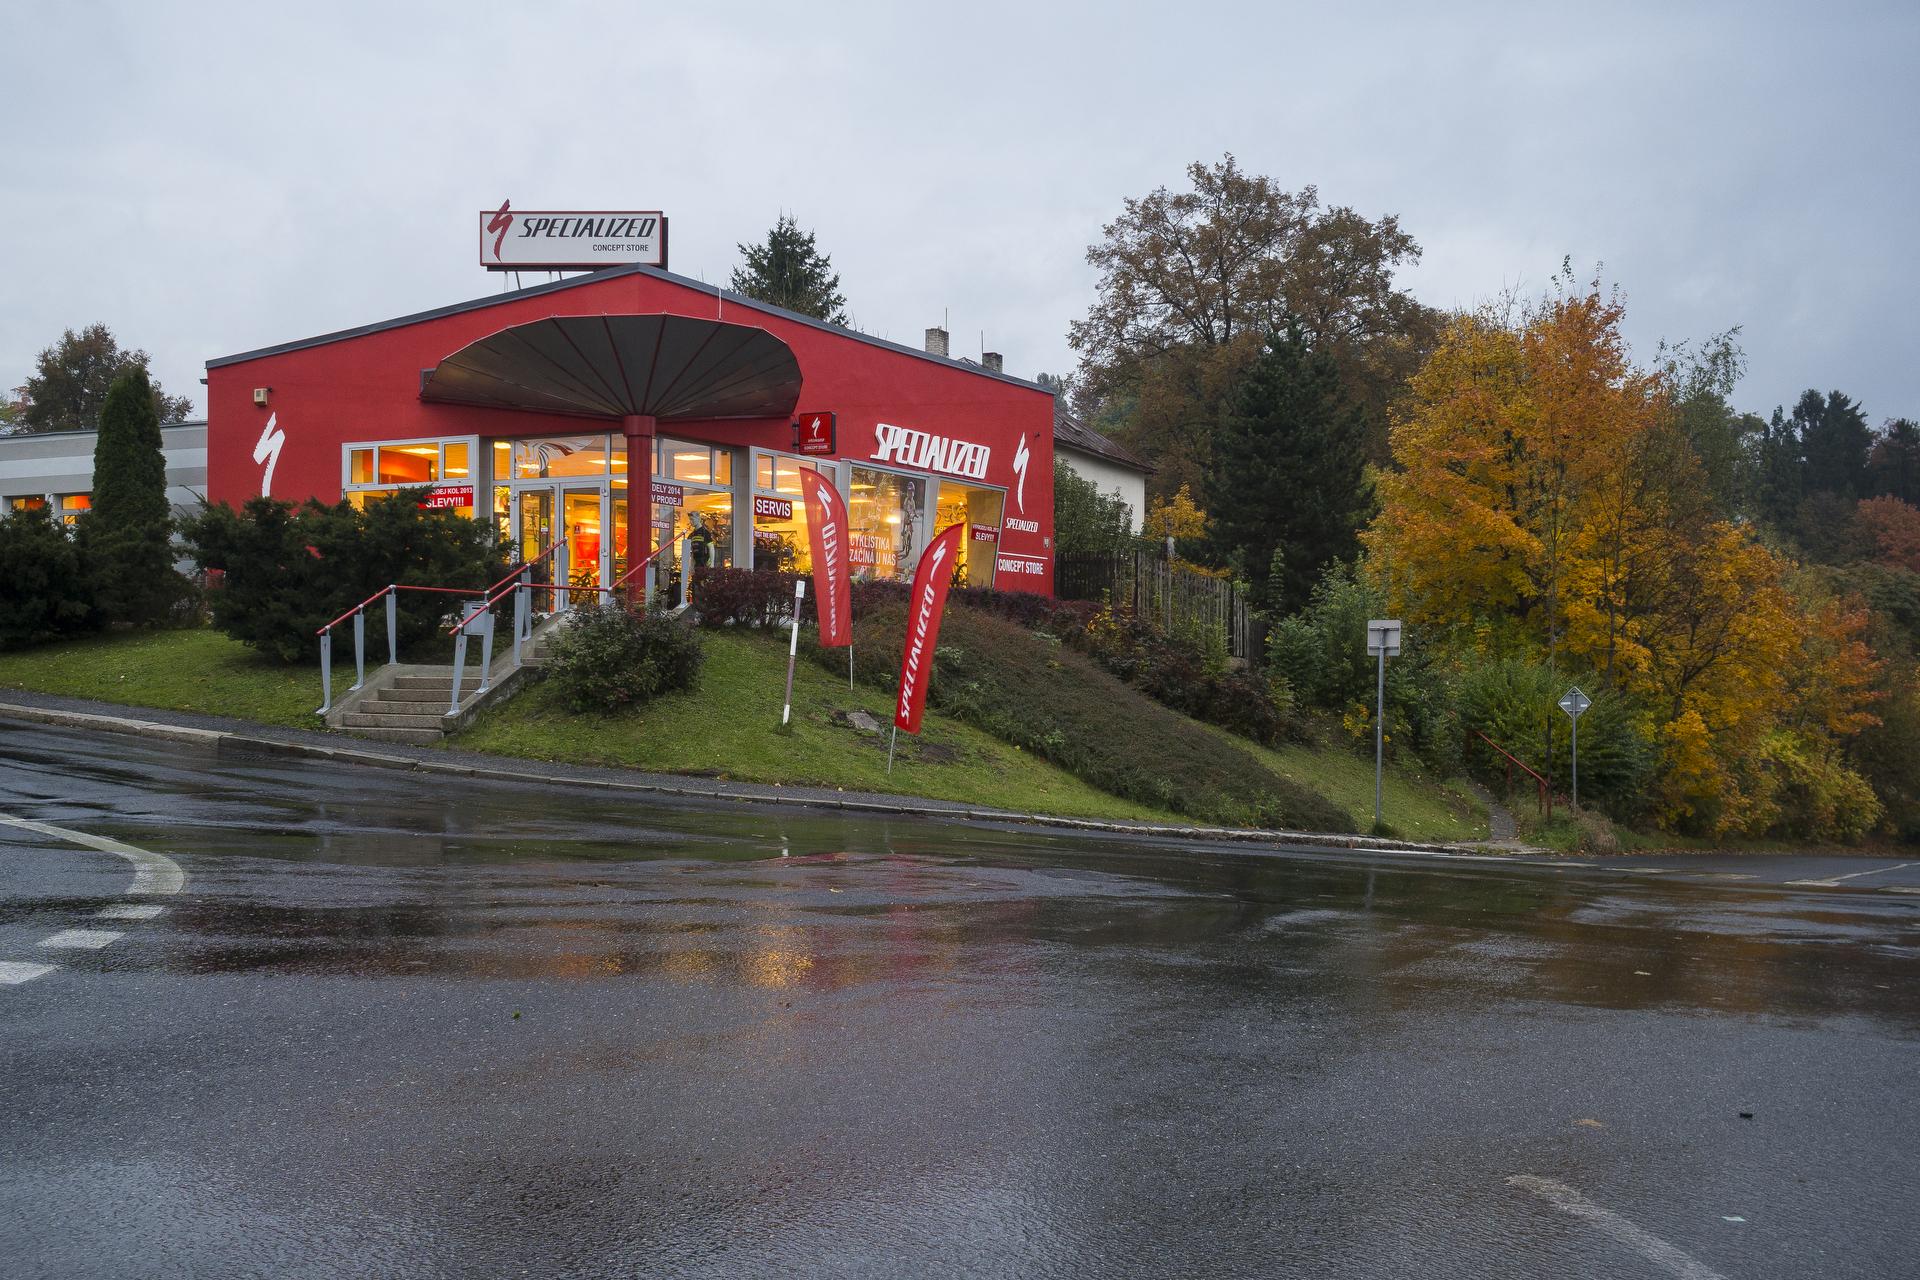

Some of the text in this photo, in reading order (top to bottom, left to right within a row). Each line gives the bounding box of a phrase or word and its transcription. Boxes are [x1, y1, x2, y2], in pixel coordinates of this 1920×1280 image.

[518, 218, 657, 238] SPECIALIZED
[592, 244, 649, 252] CONCEPT STORE
[869, 423, 991, 479] SPECIALIZED
[651, 494, 656, 503] V
[667, 487, 681, 495] 2014
[756, 499, 791, 517] SERVIS
[1005, 517, 1039, 533] SPECIALIZED
[850, 534, 890, 550] CYKLISTIKA
[876, 551, 881, 564] U
[998, 558, 1044, 575] CONCEPT STORE
[901, 583, 935, 725] SPECIALIZED
